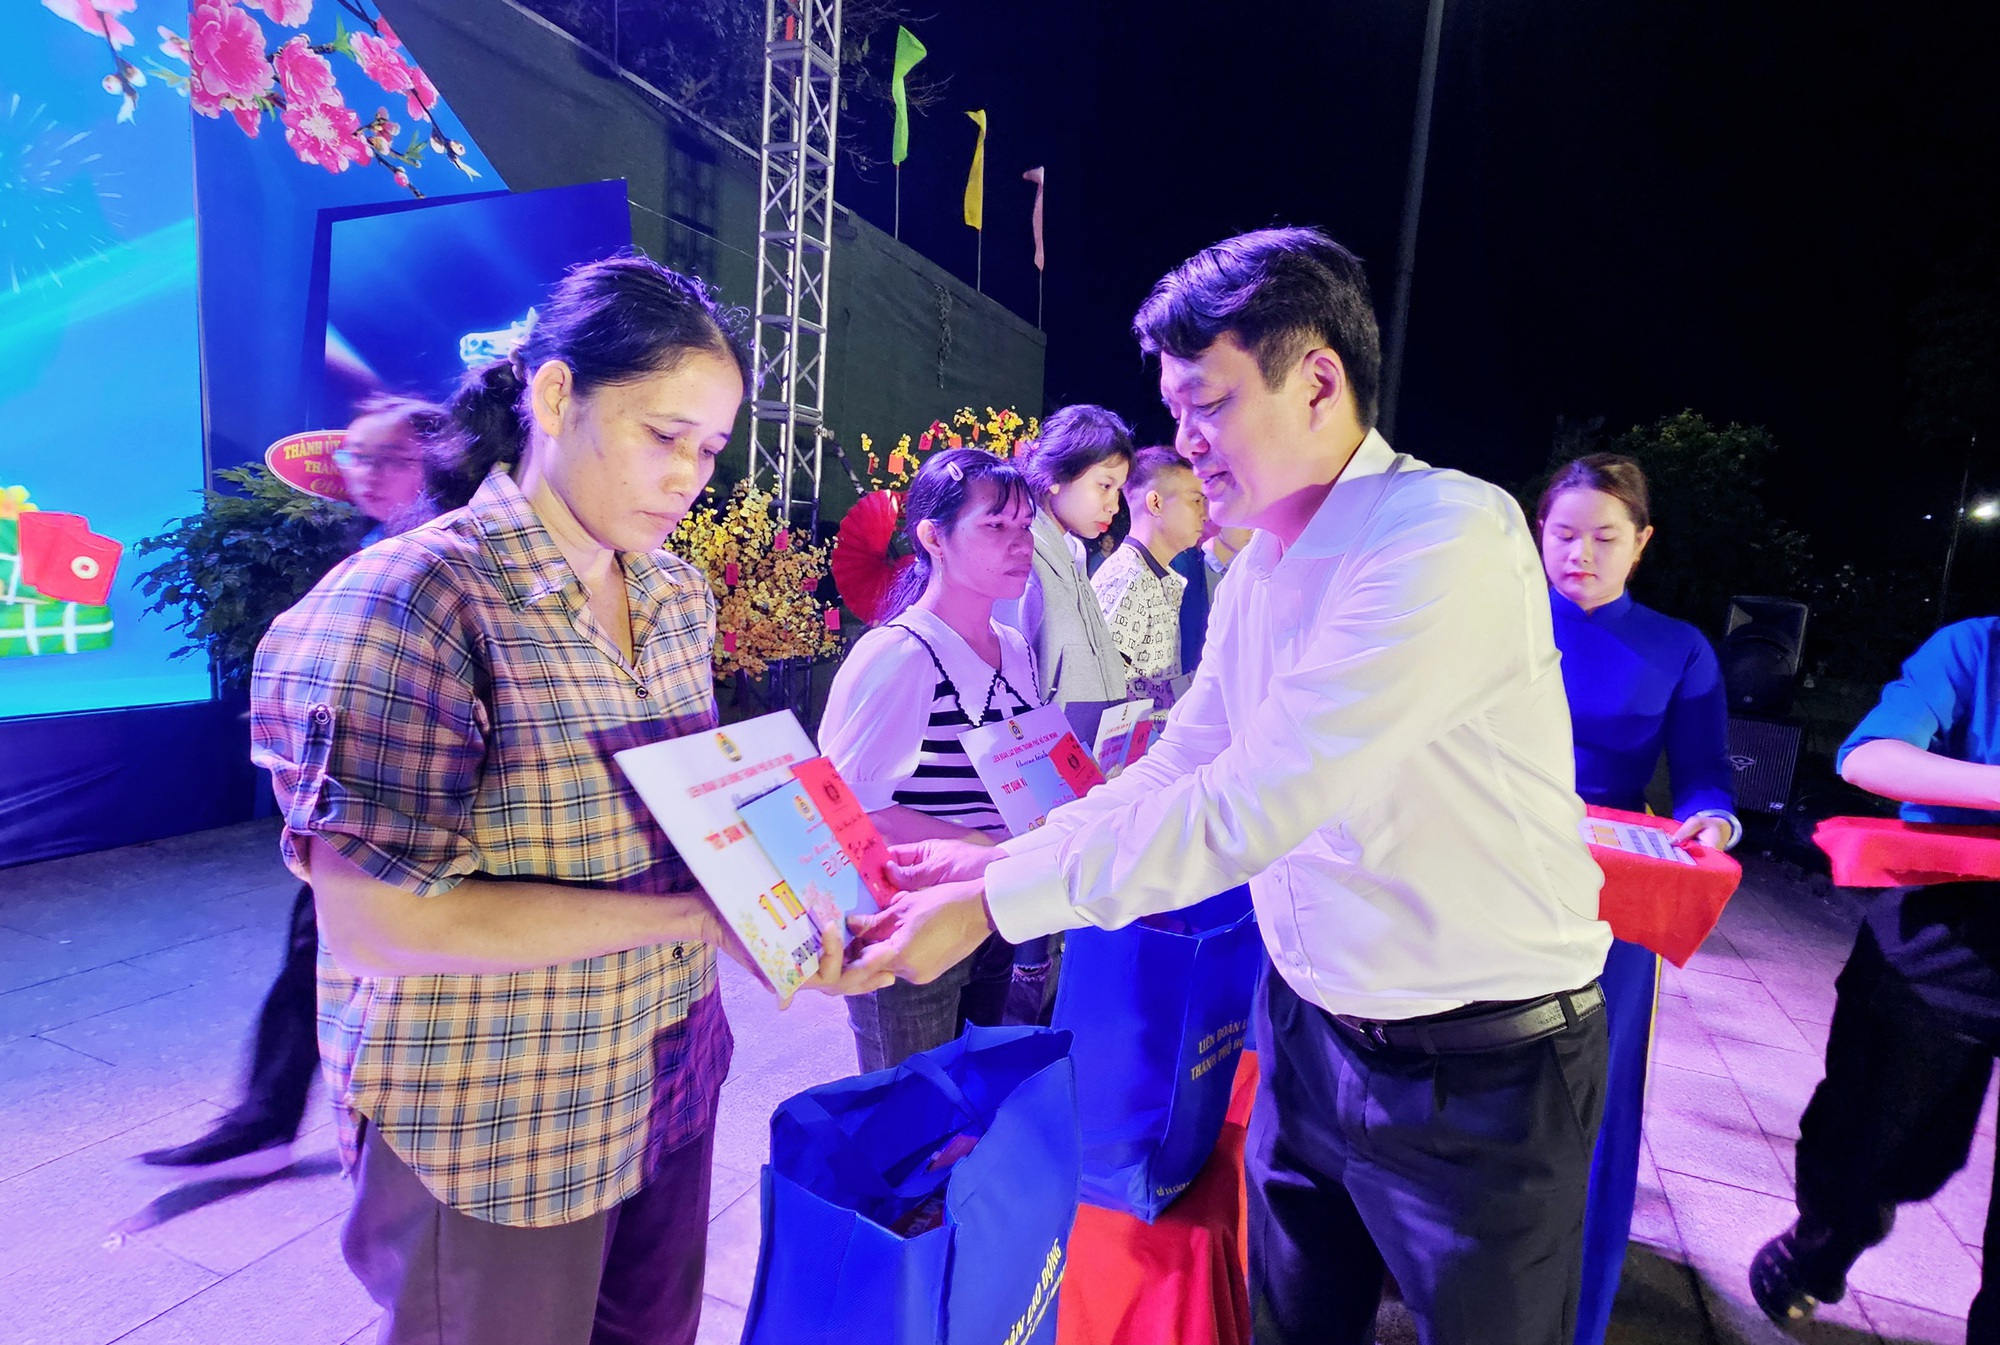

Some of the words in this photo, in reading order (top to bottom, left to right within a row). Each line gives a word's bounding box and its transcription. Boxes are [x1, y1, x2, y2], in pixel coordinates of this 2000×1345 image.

[284, 440, 322, 460] THÀNH
[304, 460, 340, 474] THÀN
[1198, 1033, 1215, 1055] LIÊN
[1216, 1020, 1241, 1042] ĐOÀN
[1190, 1053, 1217, 1081] THÀNH
[1026, 1282, 1042, 1326] LAO
[1041, 1238, 1062, 1291] ĐỘNG
